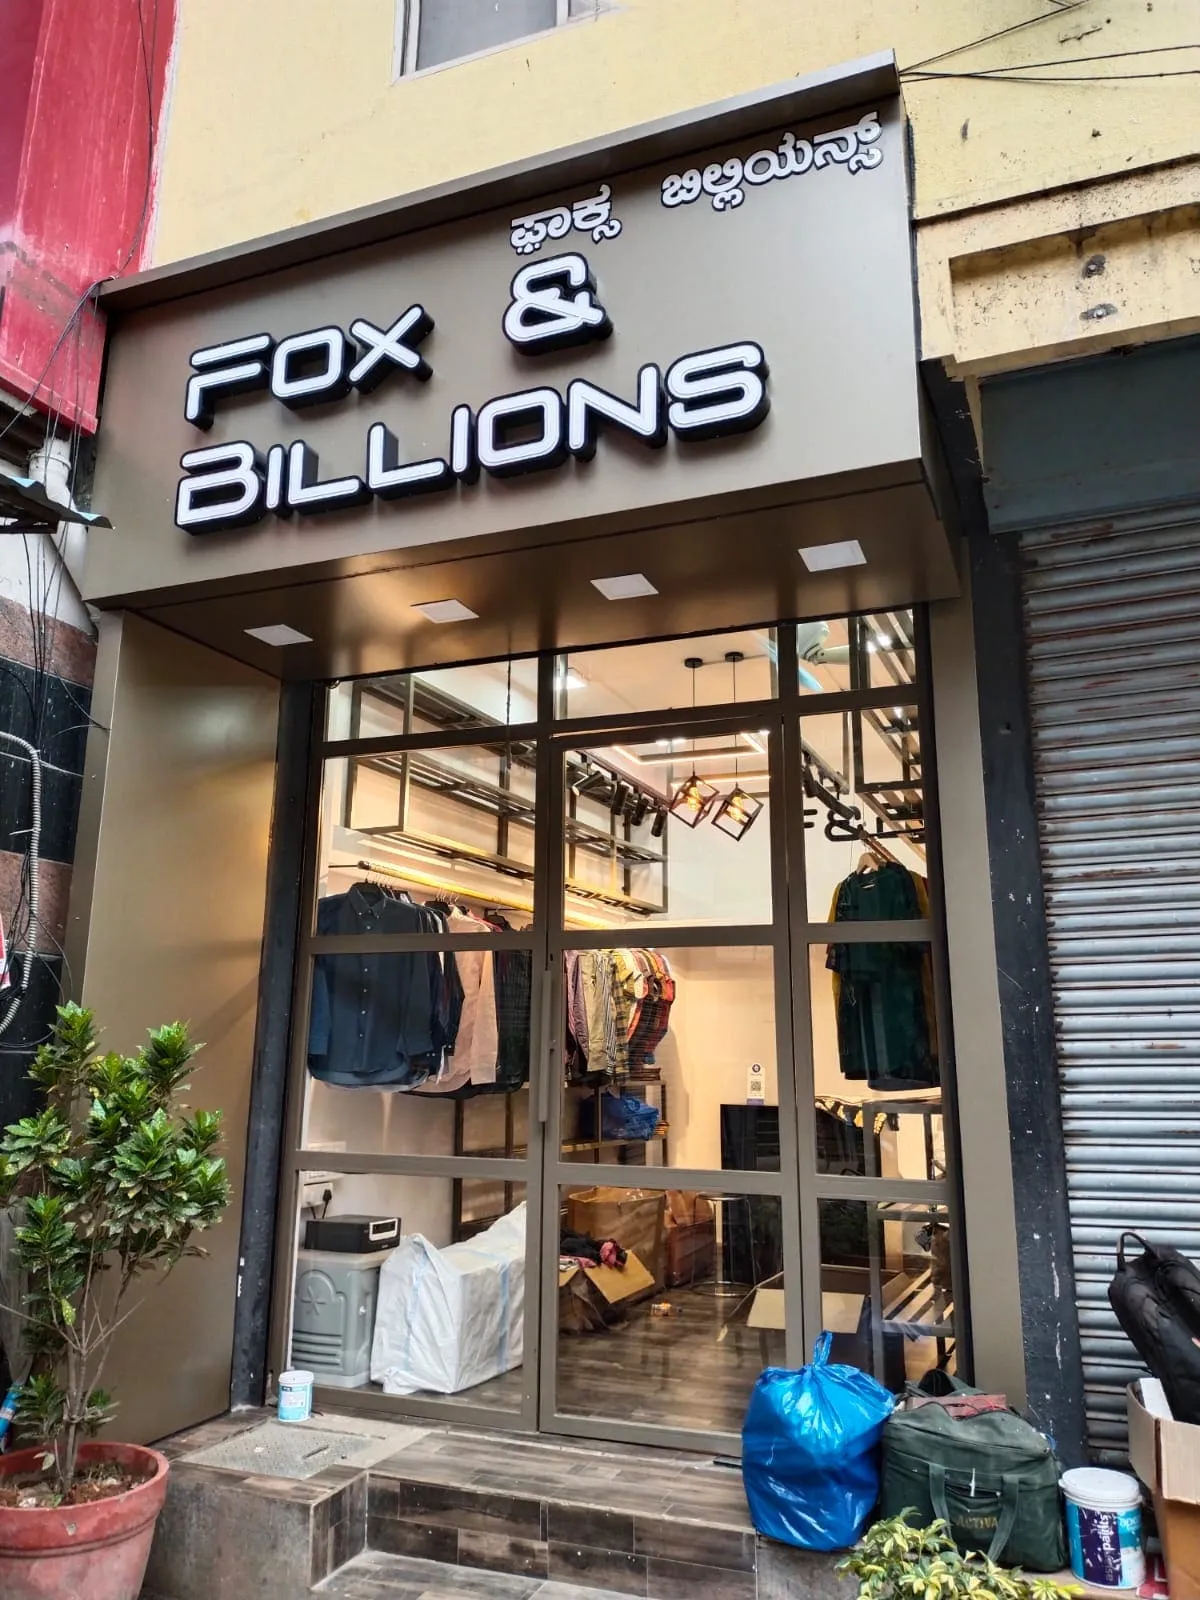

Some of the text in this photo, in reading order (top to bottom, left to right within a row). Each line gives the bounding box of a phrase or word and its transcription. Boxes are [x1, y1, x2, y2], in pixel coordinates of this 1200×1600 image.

[660, 111, 884, 212] ಬಿಲ್ಲಿಯನ್ಸ್
[184, 252, 612, 430] FOX &
[174, 341, 769, 534] BILLIONS
